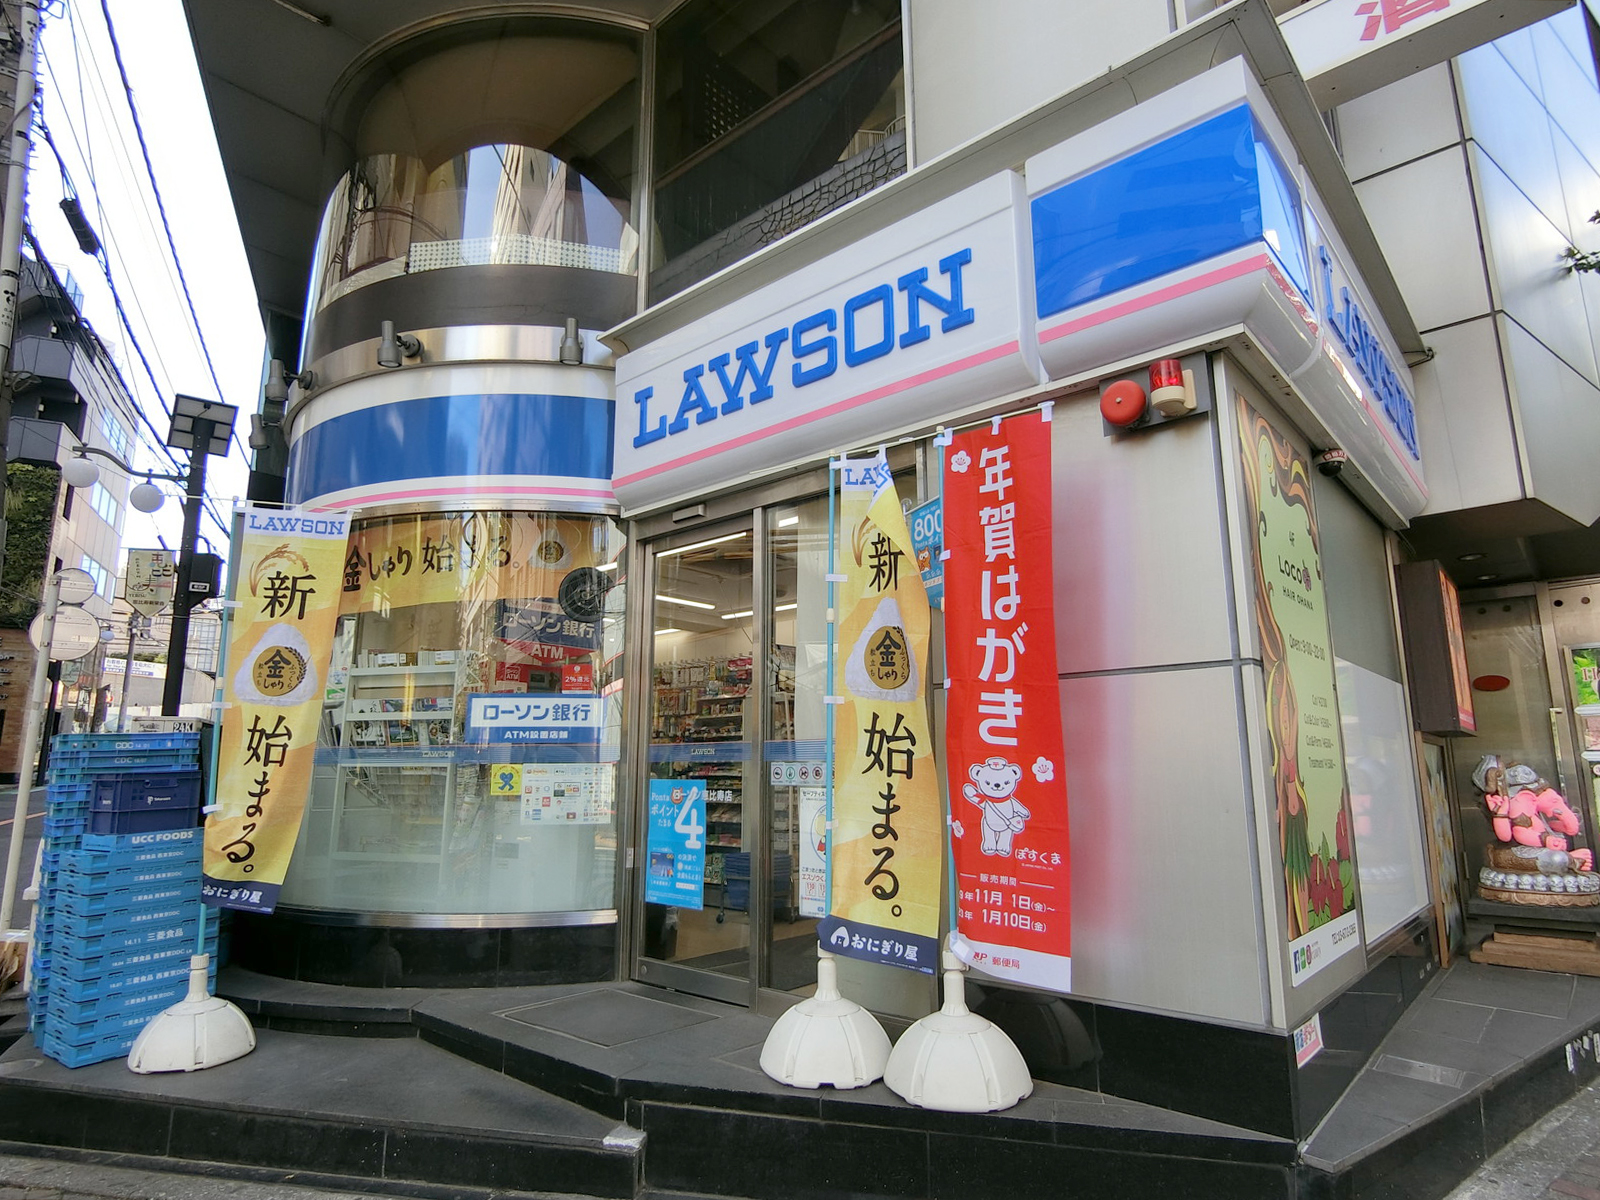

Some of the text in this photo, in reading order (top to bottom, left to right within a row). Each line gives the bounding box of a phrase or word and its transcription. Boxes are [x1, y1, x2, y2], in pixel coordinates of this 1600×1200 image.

[633, 248, 975, 449] LAWSON
[249, 515, 345, 535] LAWSON
[868, 532, 904, 593] 新
[261, 571, 317, 620] 新
[976, 445, 1029, 746] 年賀はがき
[1282, 586, 1314, 611] HAIR OHANA
[503, 612, 595, 639] ローソン銀行
[531, 644, 564, 660] ATM
[876, 630, 901, 667] 金
[264, 649, 292, 679] 金
[878, 667, 898, 681] しゃり
[264, 678, 284, 690] しゃり
[483, 703, 591, 721] ローソン銀行
[174, 722, 193, 733] 24K
[504, 730, 569, 739] ATM設置店舗
[691, 747, 716, 755] LAWSON
[221, 714, 293, 873] 始まる。
[651, 792, 670, 801] Ponta
[651, 803, 680, 818] ポイント
[675, 786, 704, 850] 4
[861, 711, 917, 918] 始まる。
[131, 831, 194, 844] UCC FOODS
[1015, 847, 1062, 865] ぽすくま
[980, 873, 1017, 887] 販売期間
[202, 884, 263, 904] おにぎり屋
[124, 928, 184, 946] 14.11 三菱食品
[851, 933, 918, 962] おにぎり屋
[992, 956, 1020, 969] 郵便局
